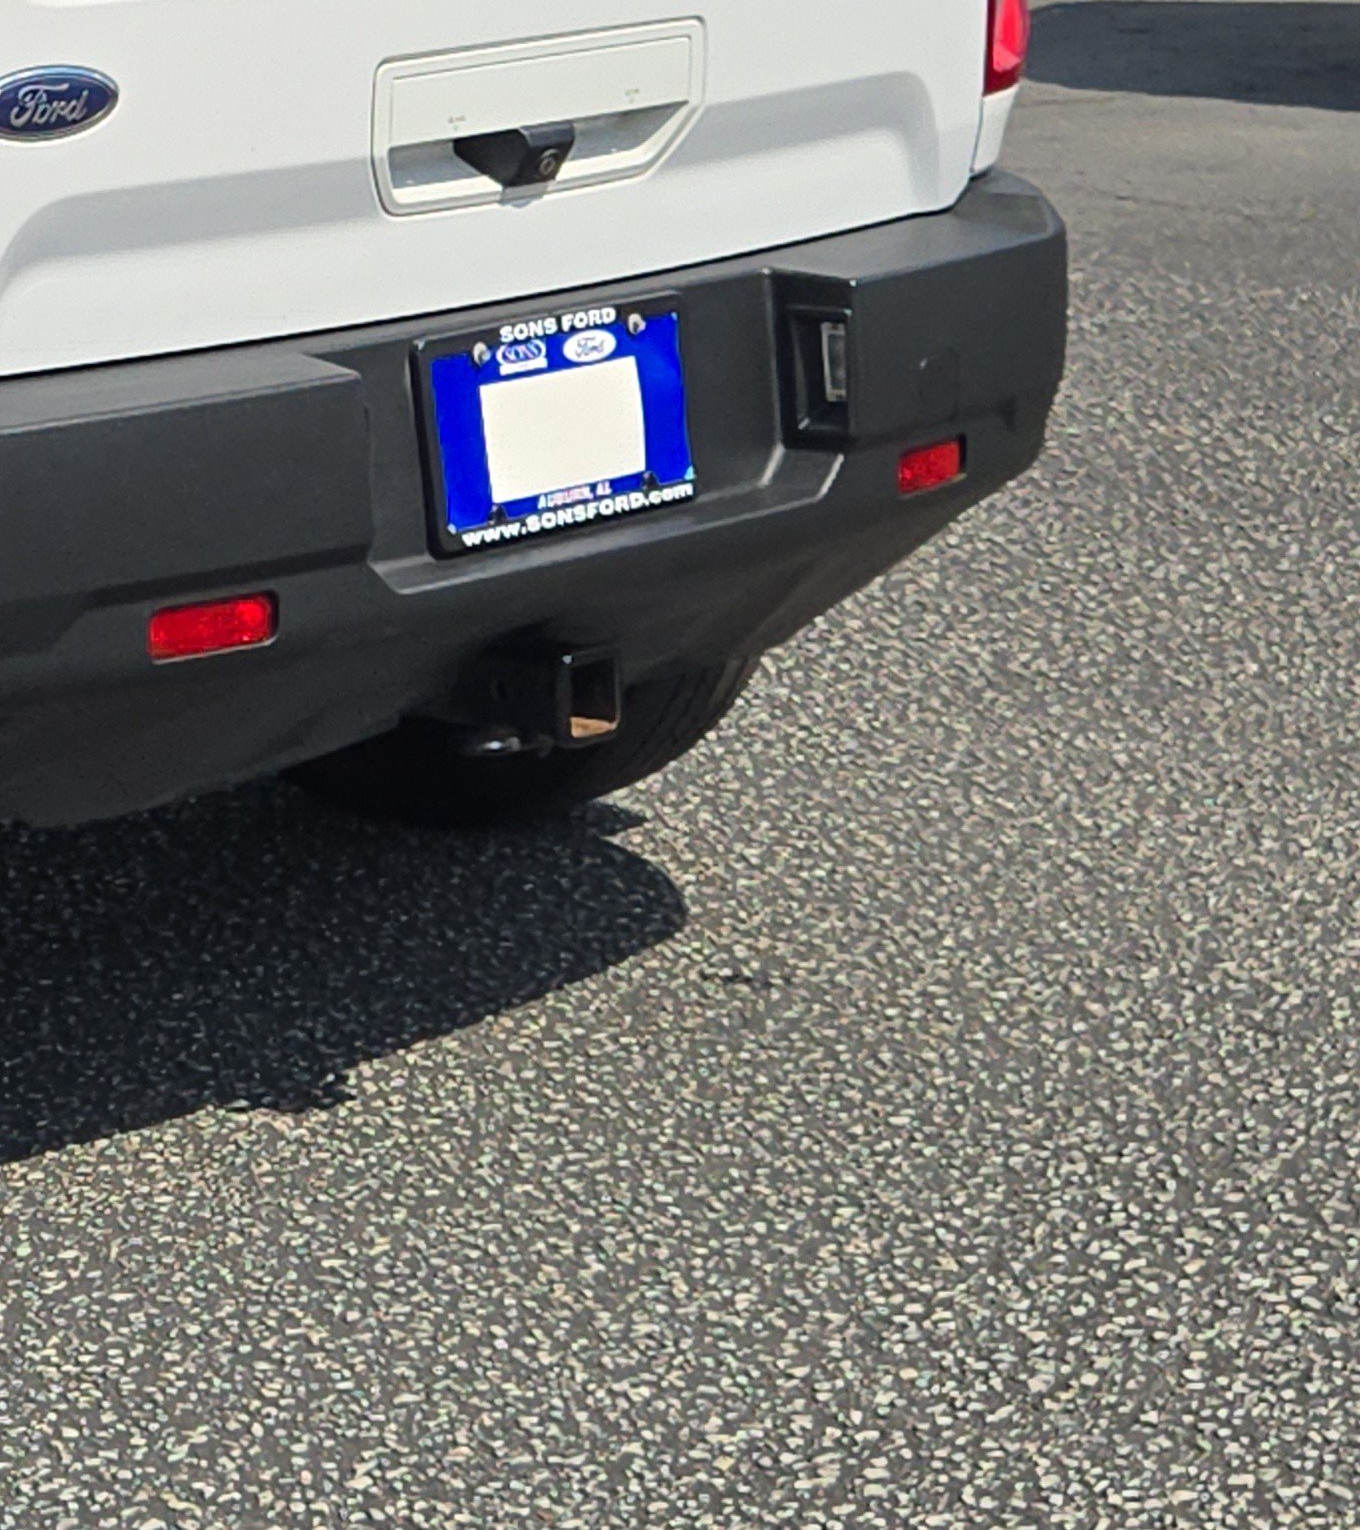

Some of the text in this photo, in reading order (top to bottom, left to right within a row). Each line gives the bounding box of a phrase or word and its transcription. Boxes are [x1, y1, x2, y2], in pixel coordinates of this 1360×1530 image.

[10, 82, 89, 127] Ford
[498, 307, 616, 343] SONS FORD
[461, 482, 695, 548] www.SONSFORD.com
